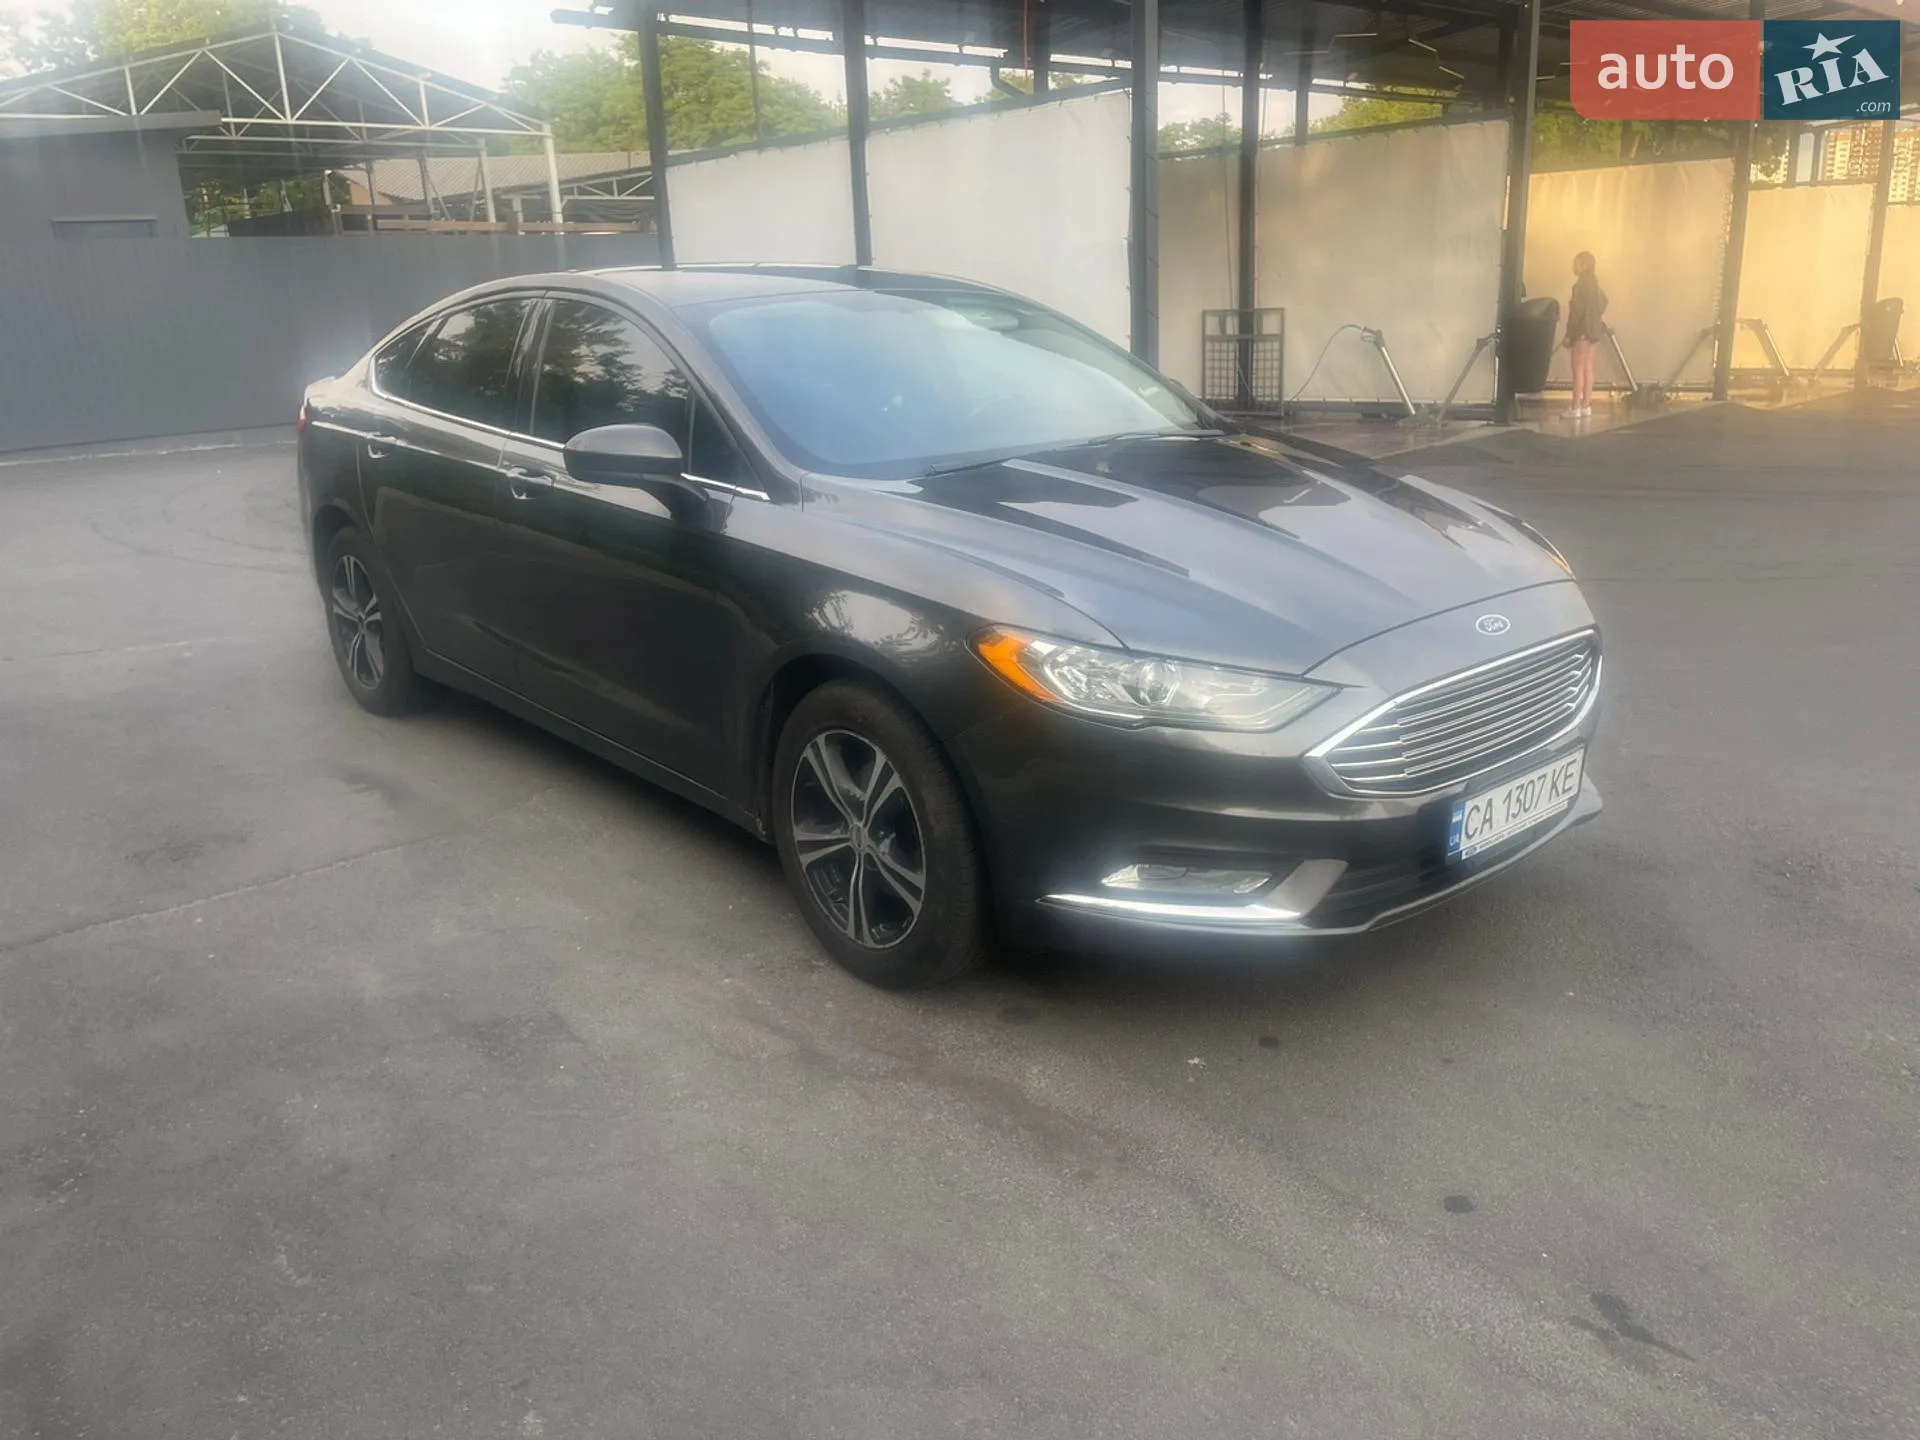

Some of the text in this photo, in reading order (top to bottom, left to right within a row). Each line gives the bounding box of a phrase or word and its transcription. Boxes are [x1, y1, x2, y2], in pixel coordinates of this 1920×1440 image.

[1464, 797, 1493, 840] CA
[1502, 774, 1548, 823] 1307
[1549, 758, 1577, 803] KE
